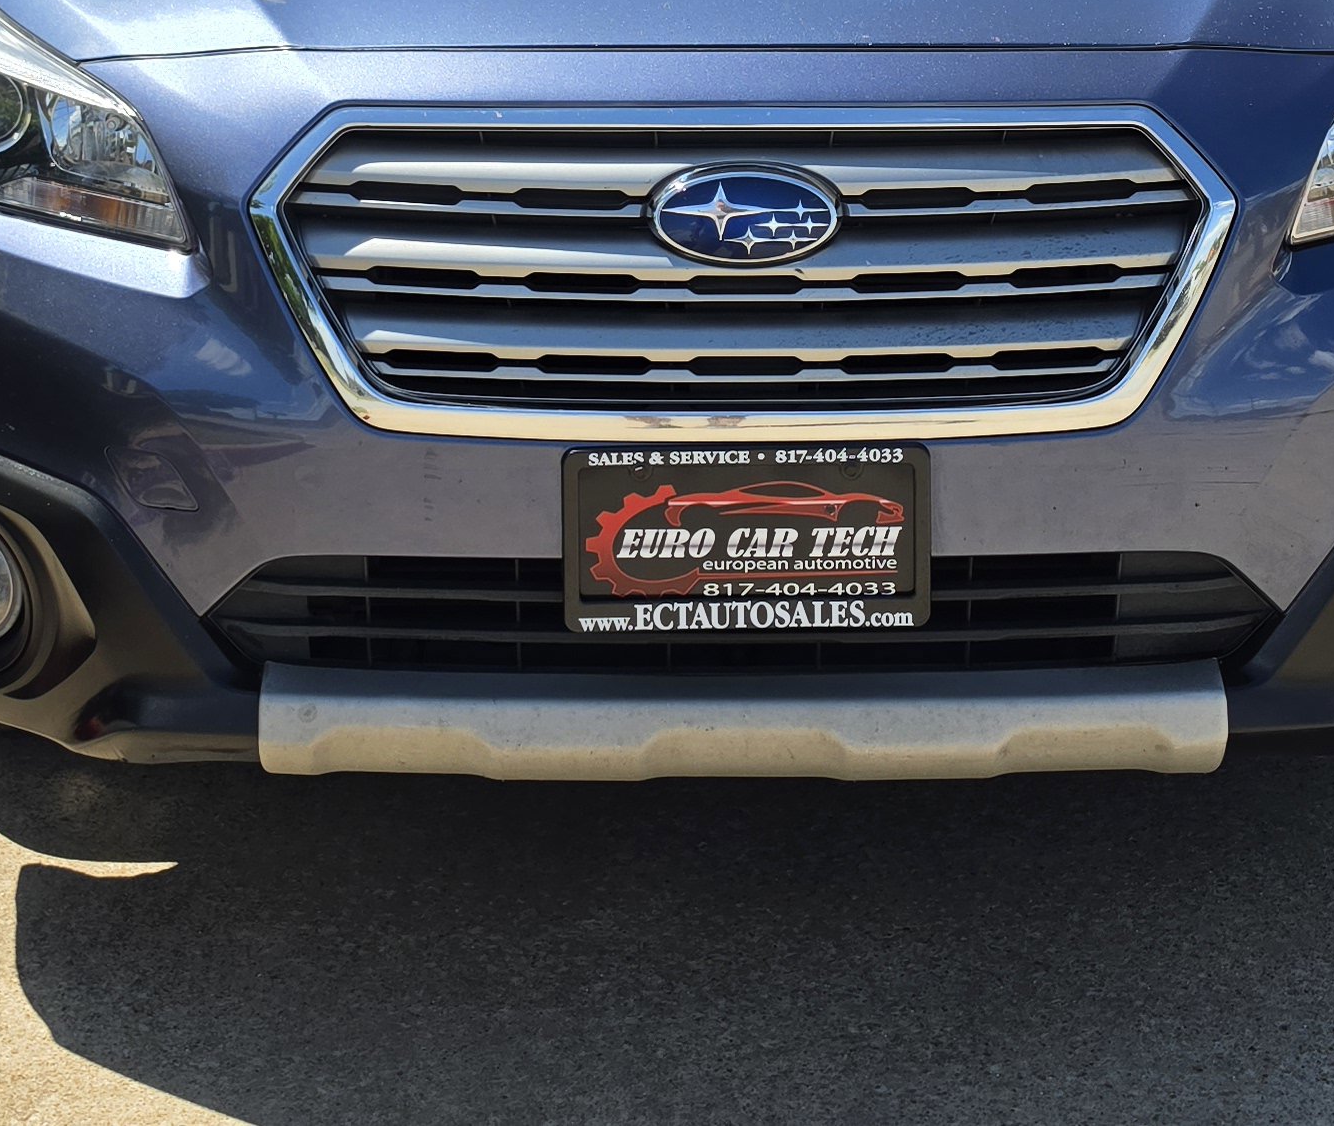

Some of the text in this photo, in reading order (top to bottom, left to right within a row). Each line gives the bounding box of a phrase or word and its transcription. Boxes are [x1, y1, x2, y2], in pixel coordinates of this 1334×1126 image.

[588, 448, 904, 466] SALES & SERVICE 817-404-4033
[617, 526, 902, 559] EURO CAR TECH
[702, 556, 898, 573] european automotive
[703, 582, 896, 596] 817-404-4033
[578, 600, 914, 632] www.ECTAUTOSALES.com
